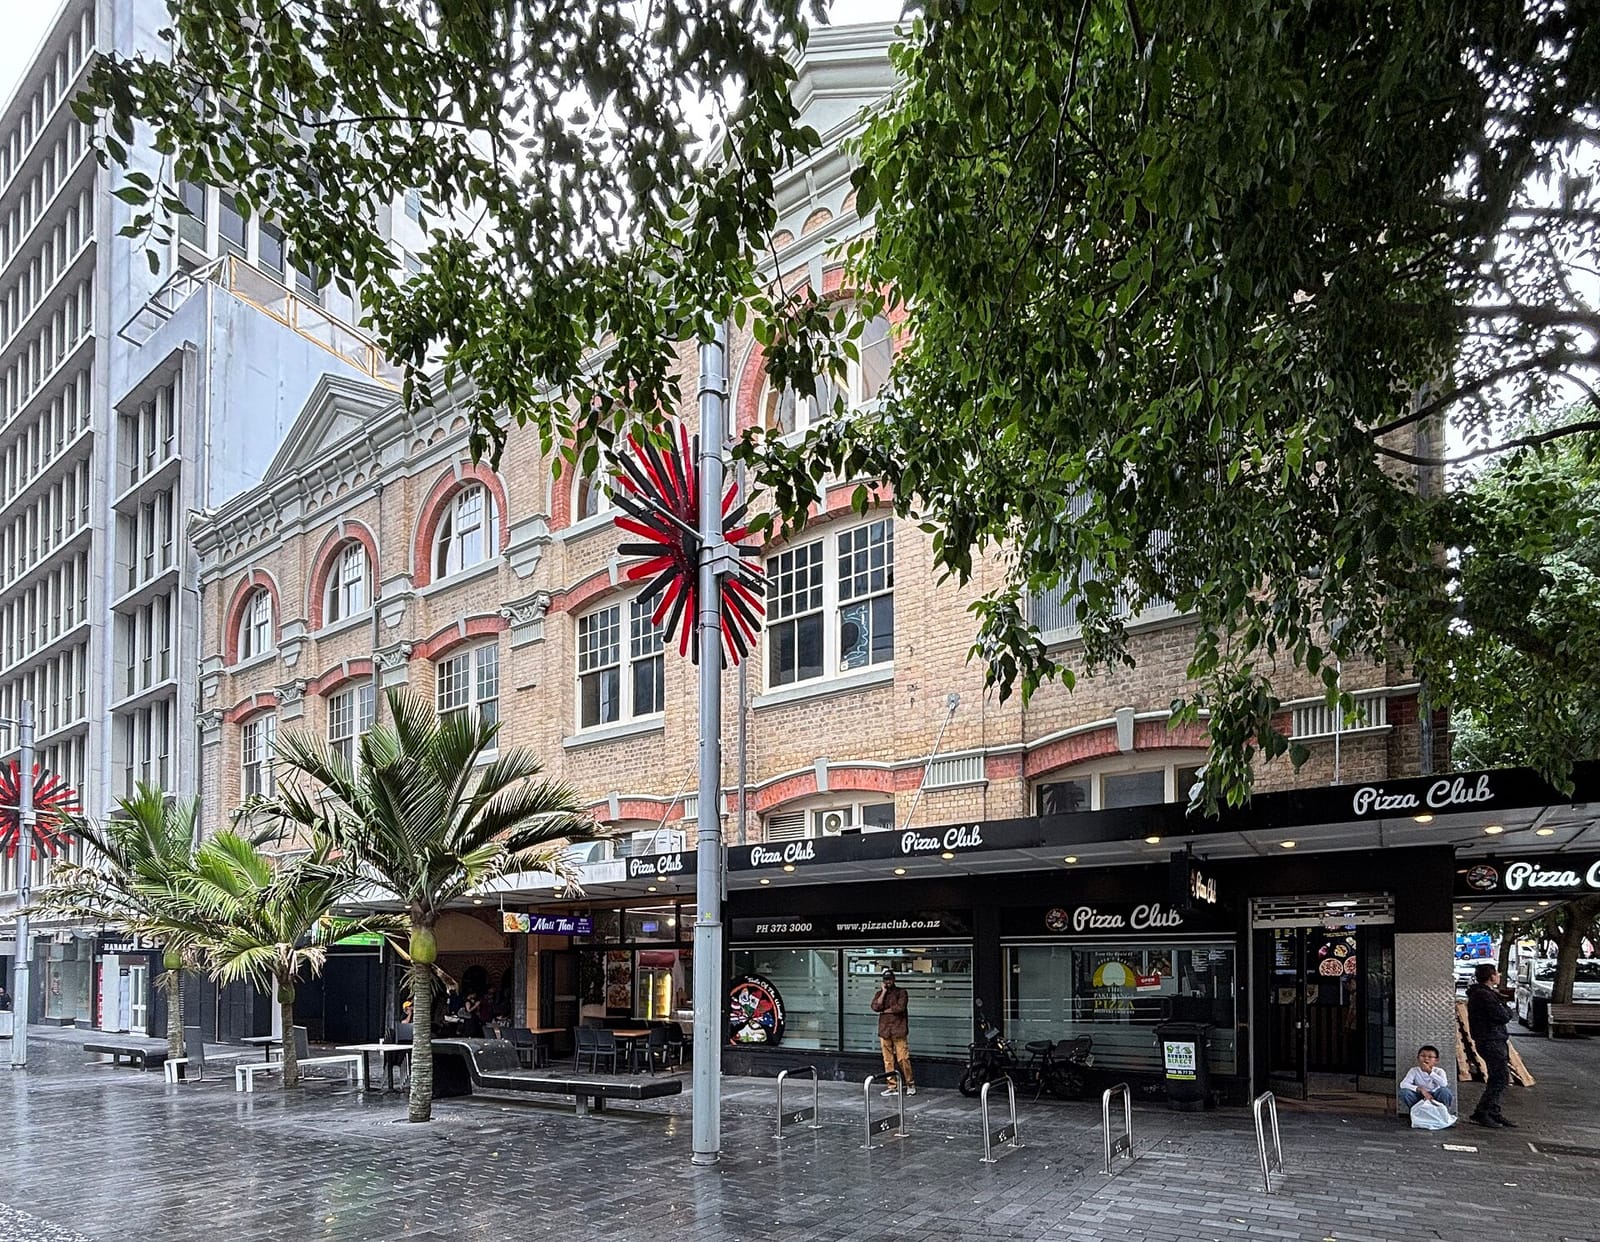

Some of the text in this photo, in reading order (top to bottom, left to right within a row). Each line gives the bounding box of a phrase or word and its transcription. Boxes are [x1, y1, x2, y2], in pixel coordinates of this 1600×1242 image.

[1353, 774, 1495, 815] Pizza Club
[901, 825, 983, 853] Pizza Club
[630, 854, 683, 877] Pizza Club
[751, 841, 815, 866] Pizza Club
[1505, 862, 1581, 891] Pizza
[556, 918, 574, 931] Thai
[756, 922, 812, 933] PH 373 3000
[836, 919, 941, 932] www.pizzaclub.co.nz
[1073, 903, 1183, 931] Pizza Club
[1094, 1000, 1136, 1009] PIZZA
